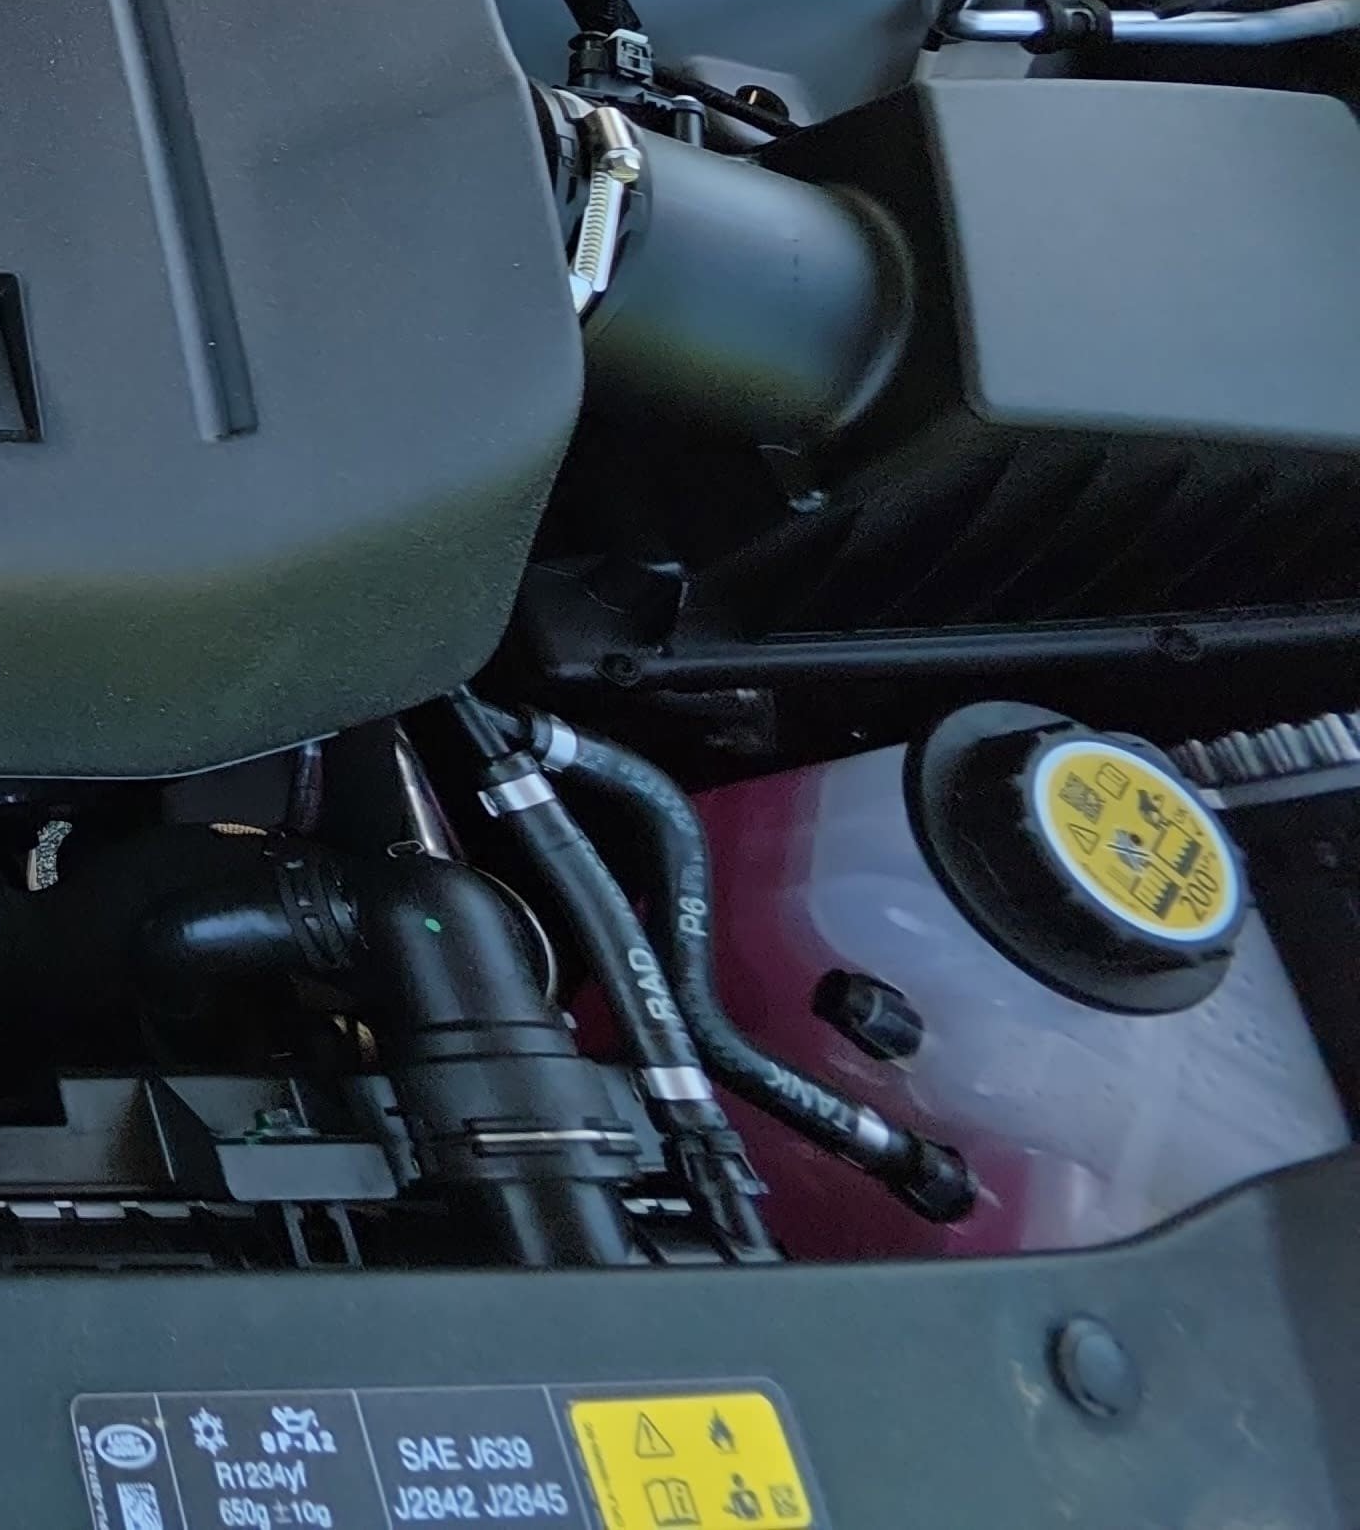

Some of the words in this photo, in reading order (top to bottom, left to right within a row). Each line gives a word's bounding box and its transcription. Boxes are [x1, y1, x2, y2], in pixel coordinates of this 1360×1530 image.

[678, 896, 708, 937] P6
[628, 948, 679, 1020] RAD
[764, 1061, 851, 1132] TANK
[397, 1436, 462, 1471] SAE
[465, 1434, 534, 1470] J639
[213, 1459, 307, 1495] R1234yf
[218, 1497, 271, 1530] 650g
[393, 1484, 480, 1520] J2842
[483, 1482, 569, 1516] J2845
